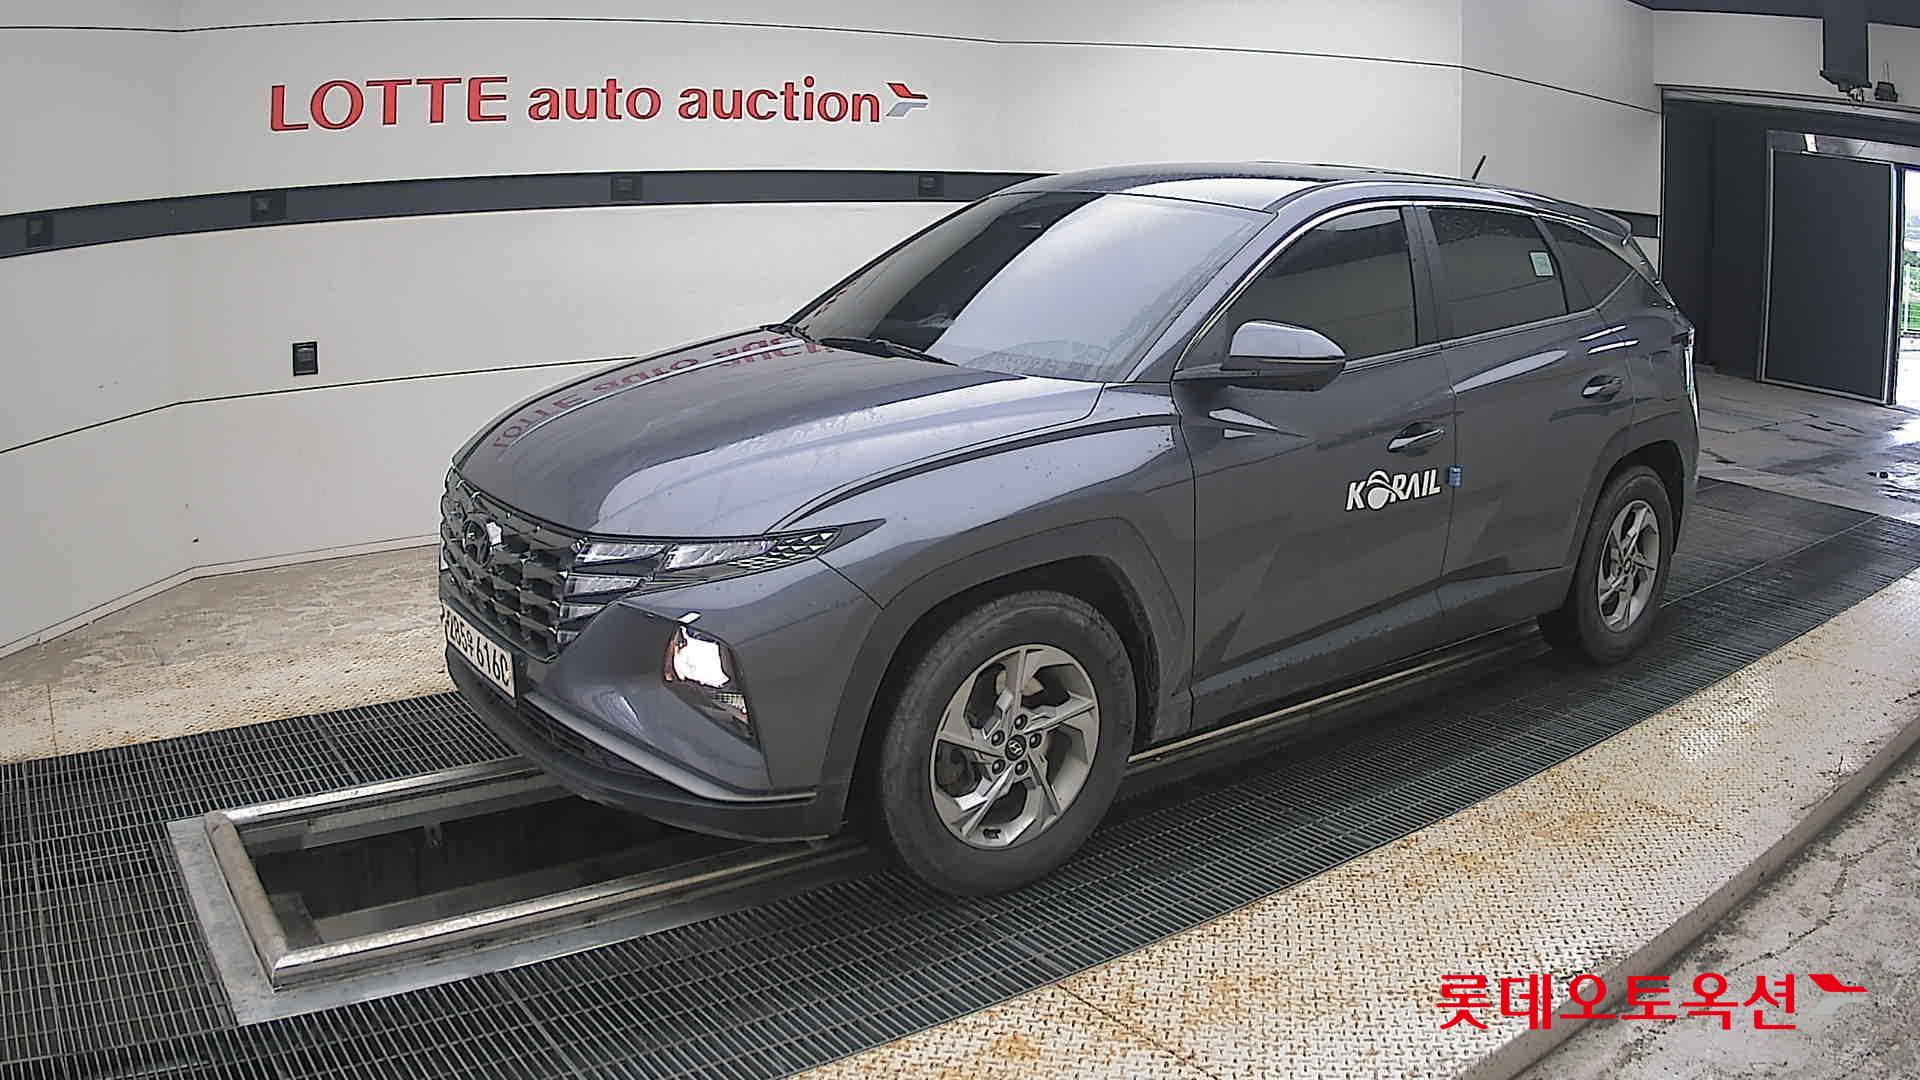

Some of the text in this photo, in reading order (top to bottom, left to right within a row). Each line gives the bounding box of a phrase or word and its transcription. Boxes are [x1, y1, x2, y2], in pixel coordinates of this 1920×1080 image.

[271, 76, 882, 132] LOTTE auto auction
[1346, 470, 1441, 511] KORAIL
